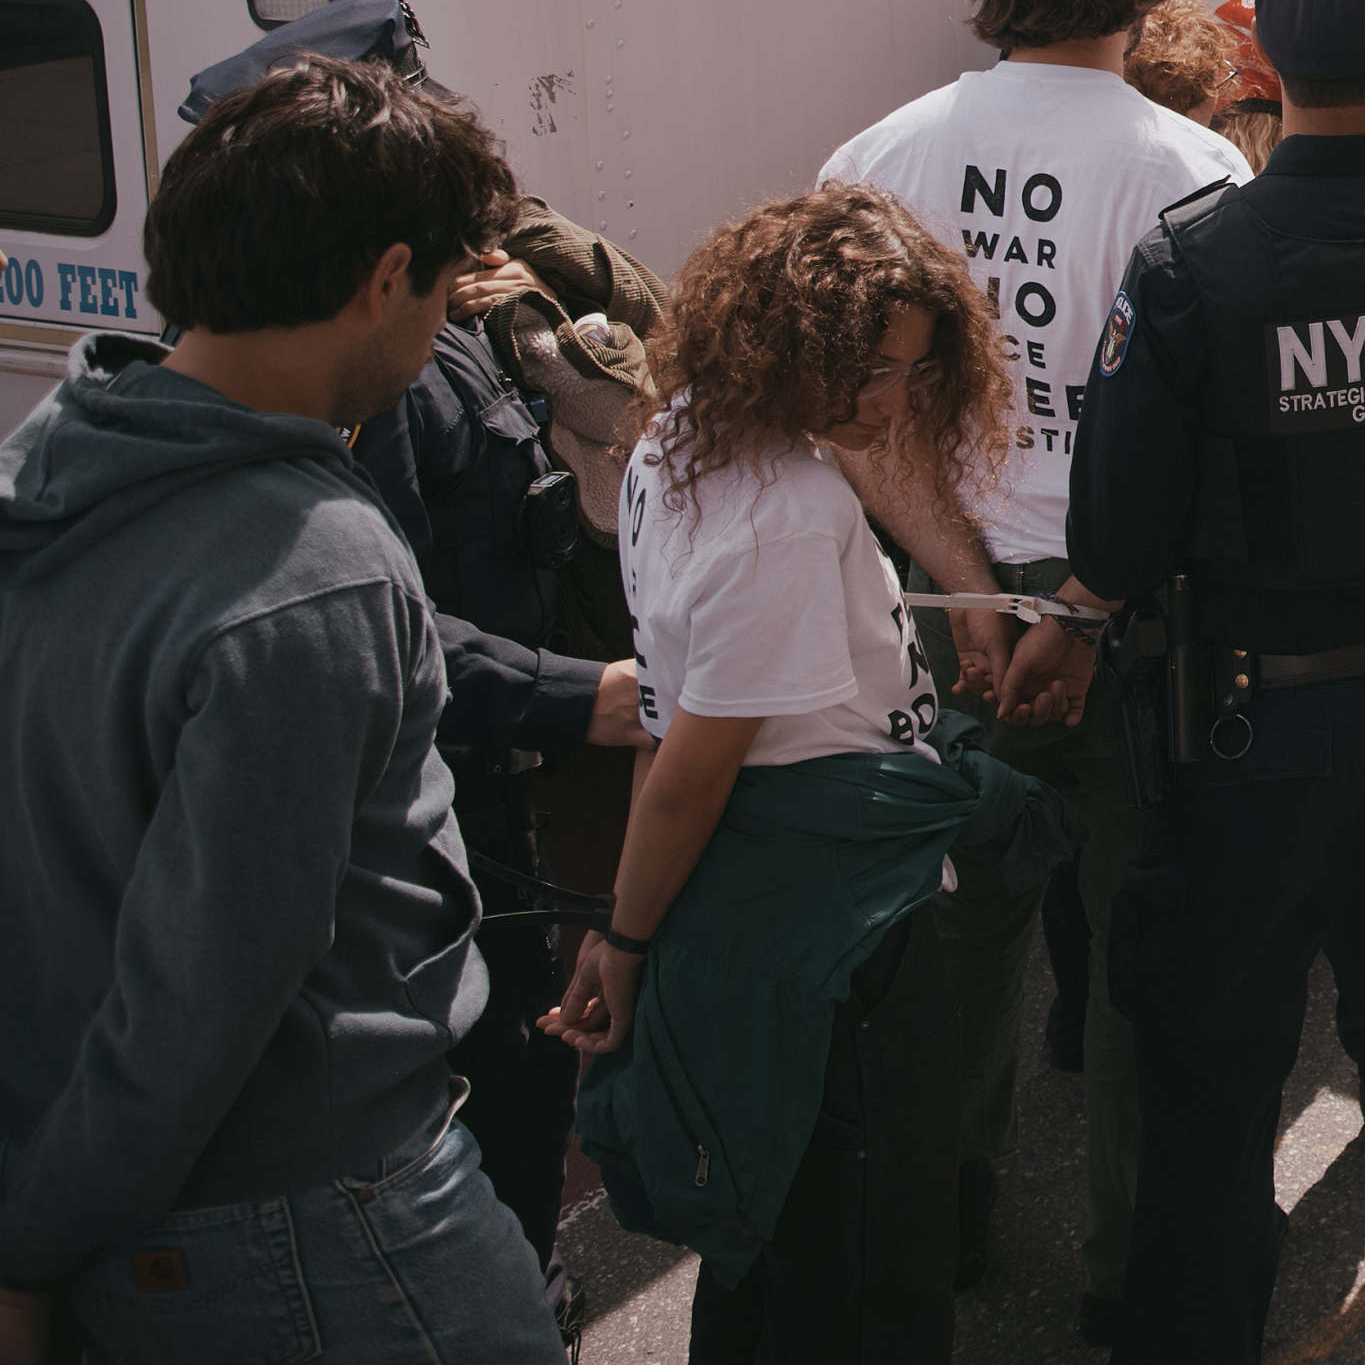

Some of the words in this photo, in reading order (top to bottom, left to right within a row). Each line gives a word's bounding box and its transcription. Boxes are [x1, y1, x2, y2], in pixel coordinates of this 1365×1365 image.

[960, 165, 1062, 222] NO
[962, 230, 1056, 269] WAR
[57, 263, 138, 319] FEET
